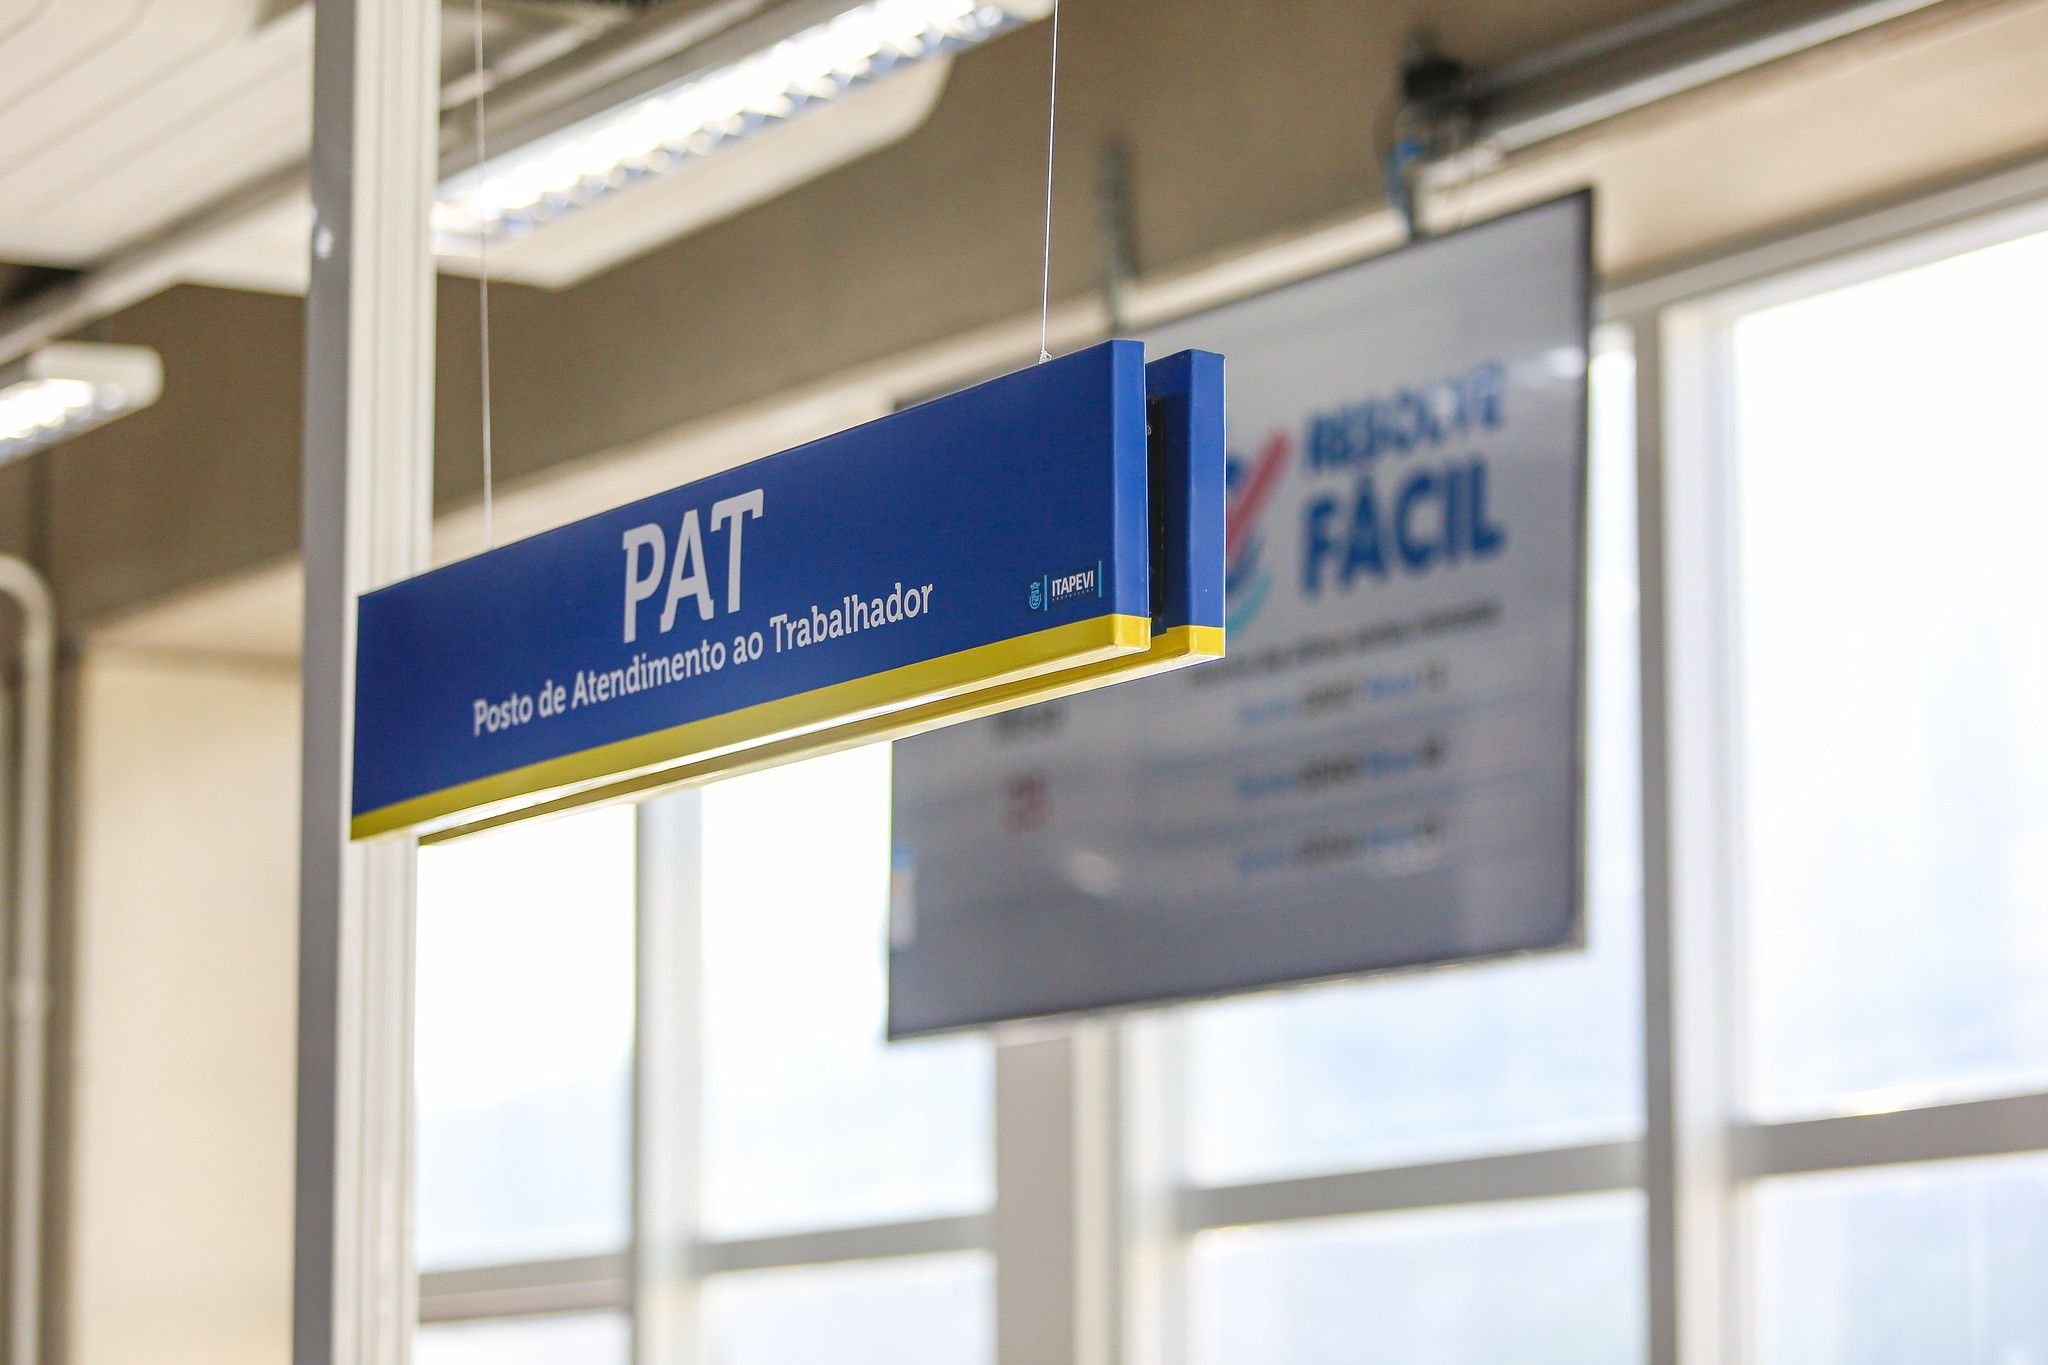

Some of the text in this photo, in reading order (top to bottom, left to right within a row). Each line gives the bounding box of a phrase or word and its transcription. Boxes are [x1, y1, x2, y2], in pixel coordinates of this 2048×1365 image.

[622, 488, 764, 644] PAT
[1051, 570, 1094, 598] ITAPEVI
[472, 581, 933, 737] Posto de Atendimento ao Trabalhador
